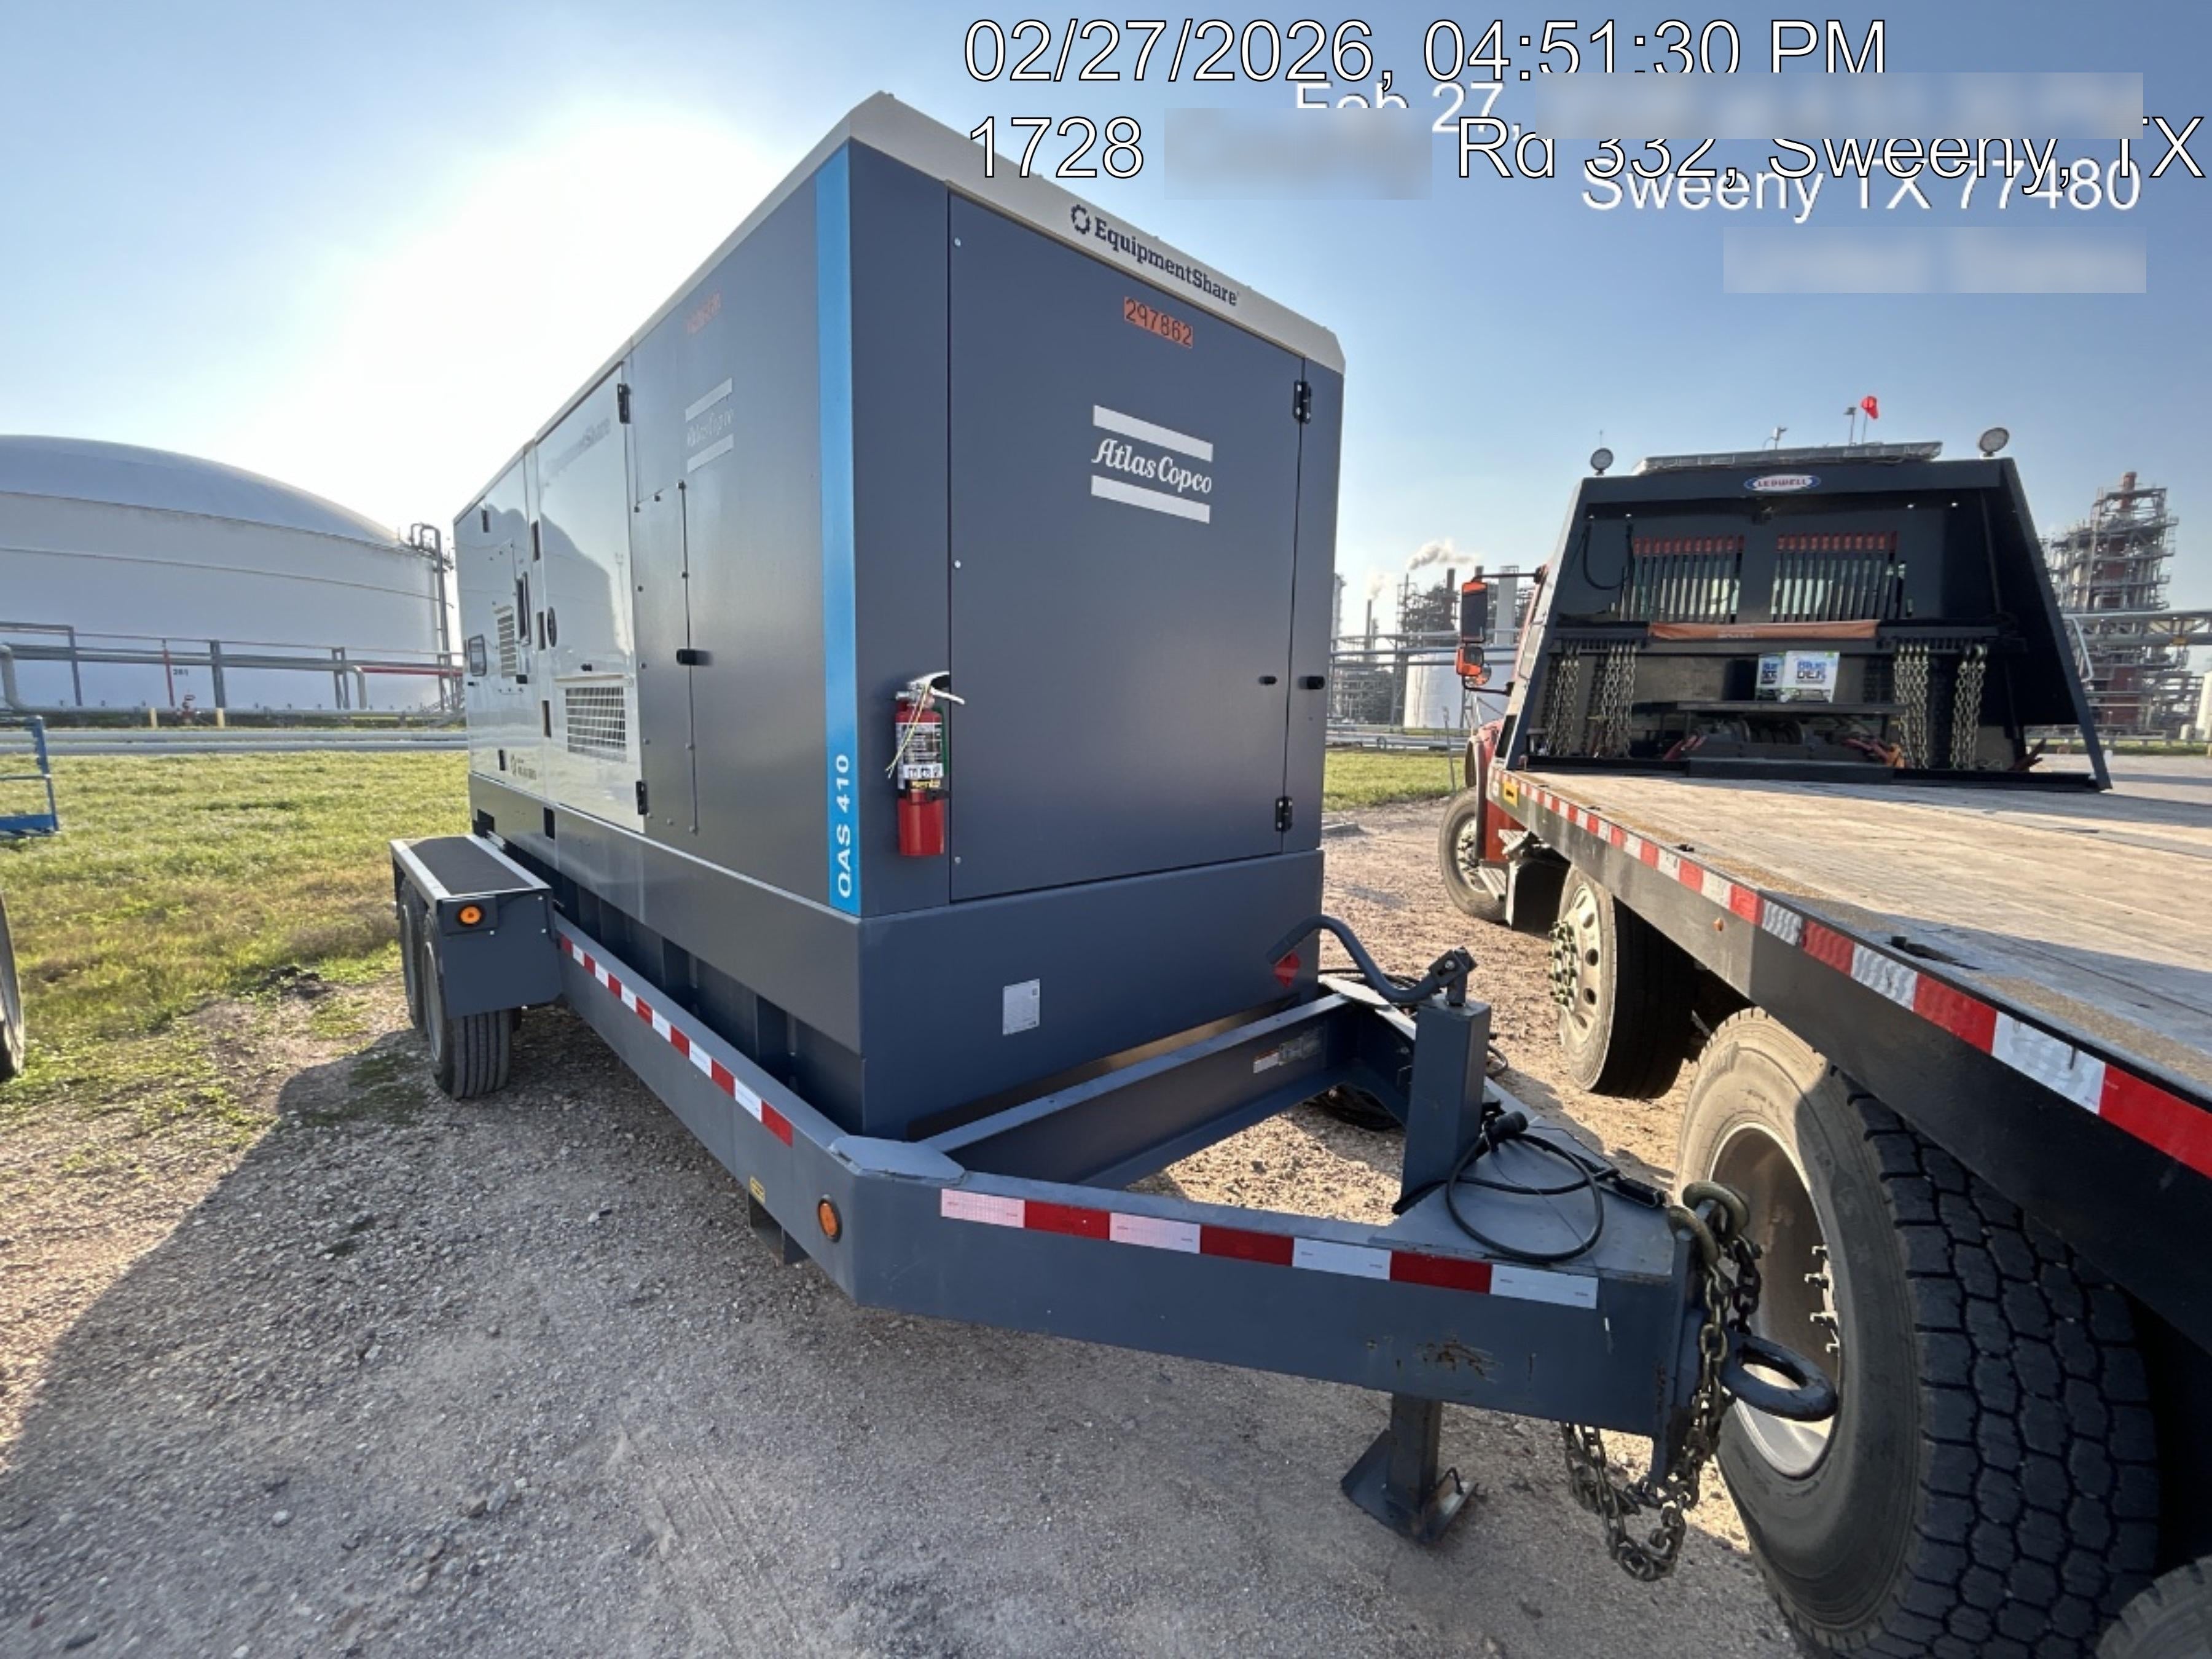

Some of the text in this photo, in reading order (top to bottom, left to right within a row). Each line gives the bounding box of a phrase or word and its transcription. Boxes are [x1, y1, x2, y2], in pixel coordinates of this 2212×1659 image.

[1094, 216, 1237, 306] EquipmentShare
[1125, 299, 1193, 347] 297862
[1091, 438, 1212, 494] Atlas Copco
[1757, 479, 1806, 487] LEDWELL
[836, 755, 852, 898] QAS 410
